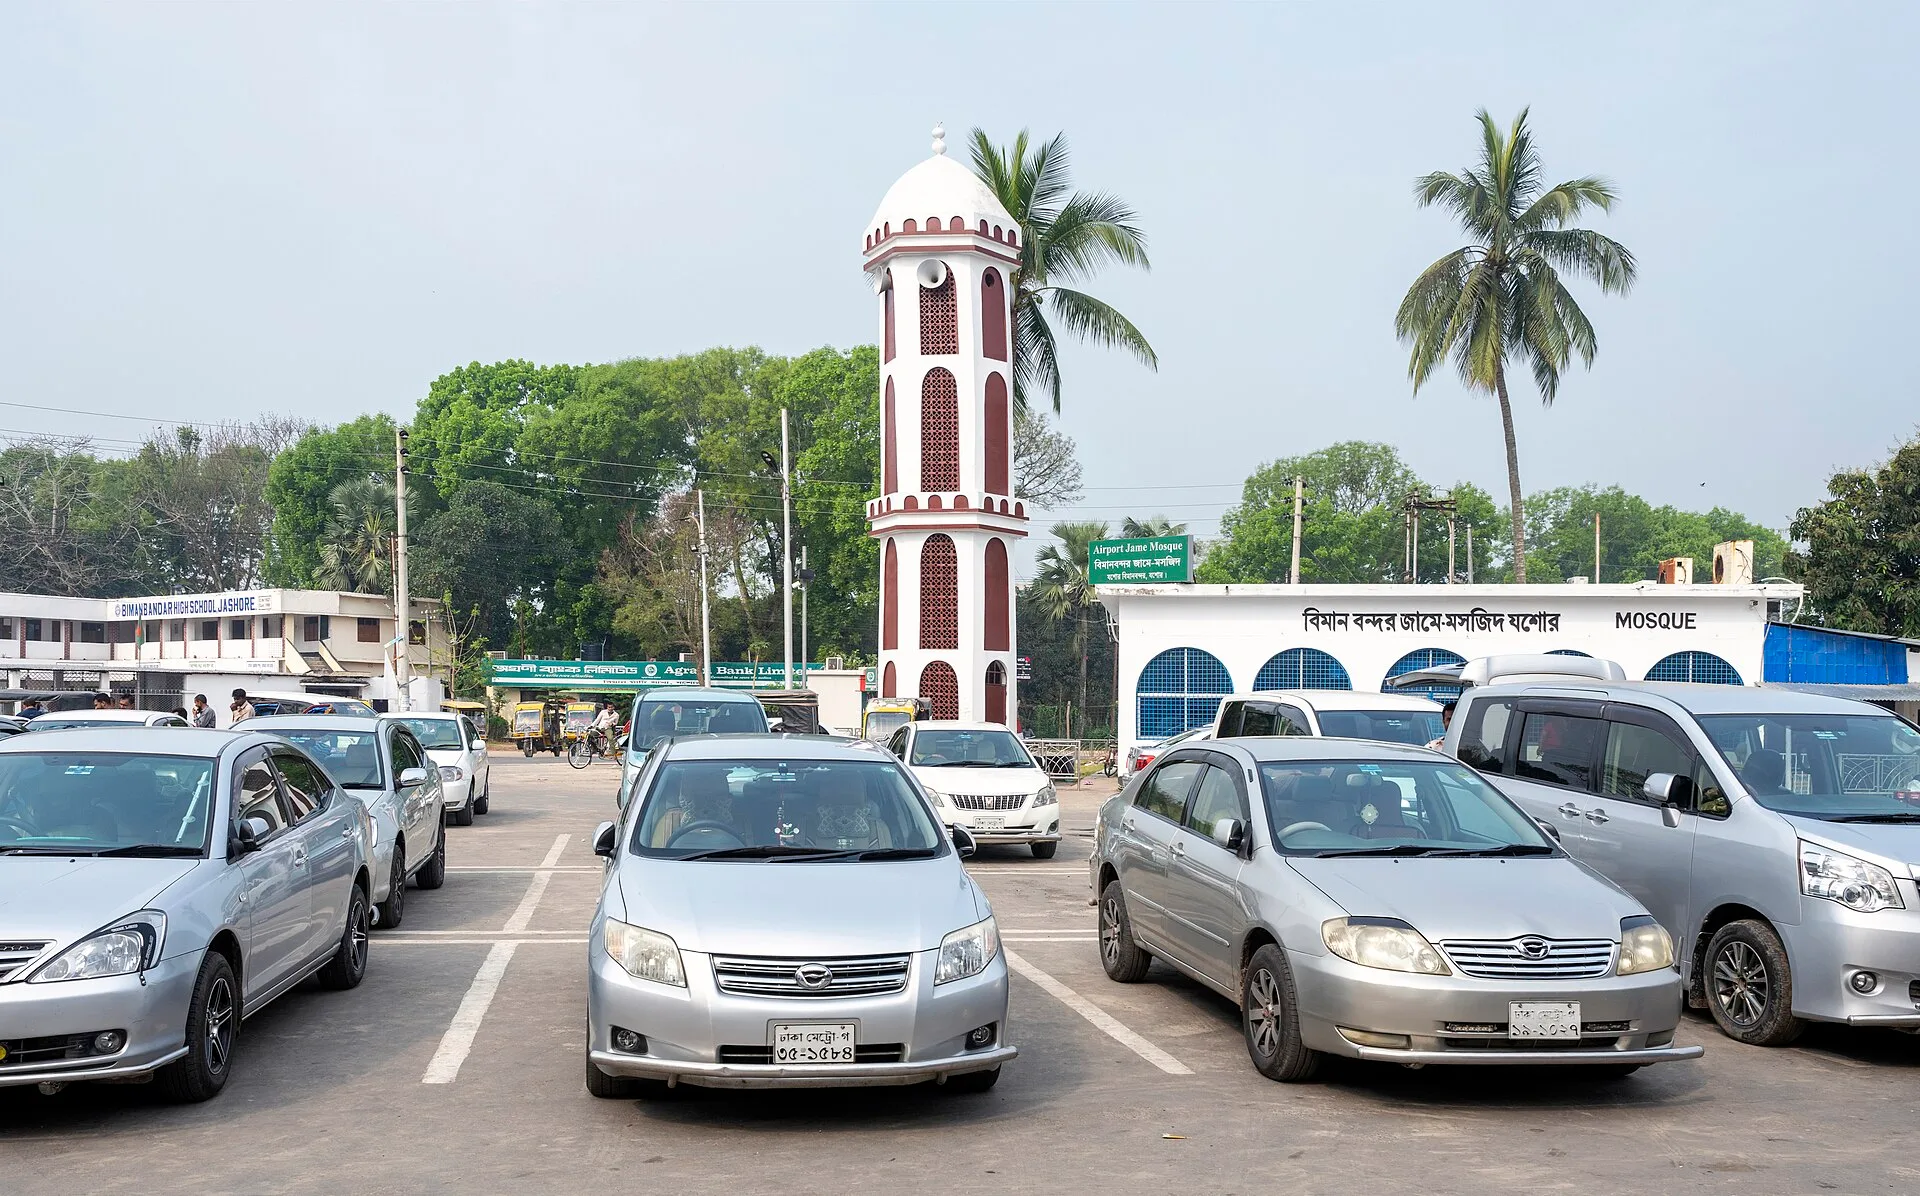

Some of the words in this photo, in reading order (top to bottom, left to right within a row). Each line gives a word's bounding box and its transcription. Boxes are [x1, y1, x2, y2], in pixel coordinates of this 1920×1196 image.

[1093, 545, 1124, 556] Airport
[1125, 543, 1148, 553] Jame
[1149, 541, 1183, 553] Mosque
[1094, 558, 1131, 569] বিমানবন্দর
[122, 602, 173, 617] BIMANBANDAR
[174, 601, 189, 615] HIGH
[190, 599, 217, 614] SCHOOL
[1302, 607, 1349, 633] বিমান
[1352, 612, 1396, 633] বন্দর
[1508, 612, 1561, 633] যশোর
[1615, 612, 1697, 630] MOSQUE
[539, 665, 582, 674] ব্যাংক
[584, 665, 638, 675] লিমিটেড
[664, 666, 712, 676] Agra
[716, 666, 754, 675] Bank
[779, 1032, 803, 1042] ঢাকা
[776, 1046, 852, 1060] ৩৫-১৫৮৪
